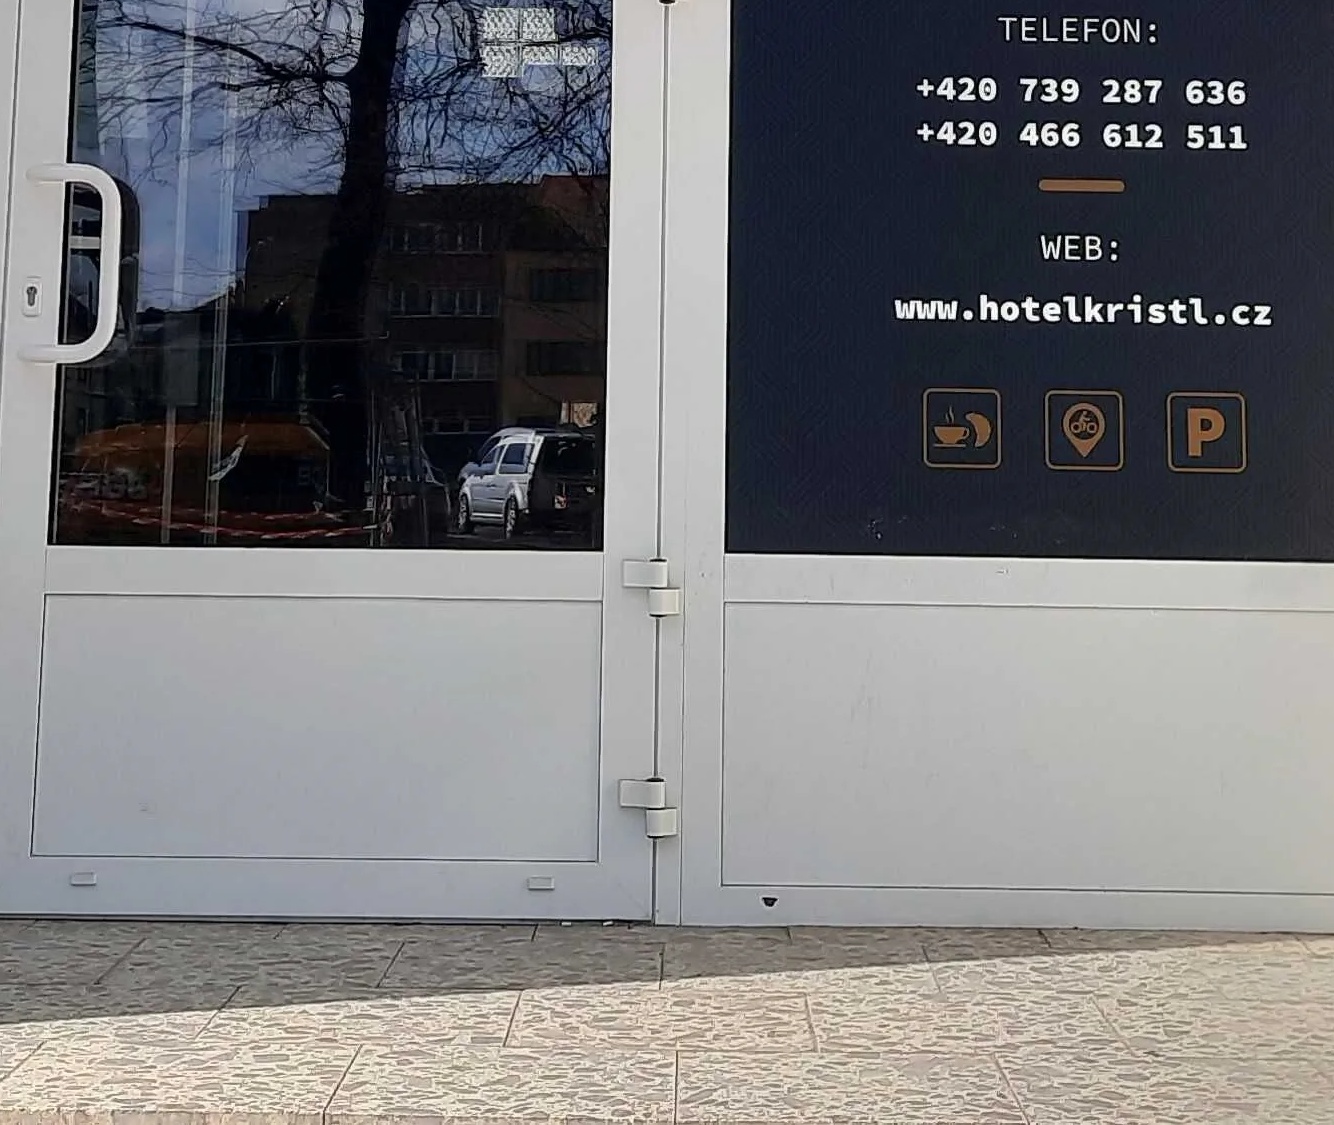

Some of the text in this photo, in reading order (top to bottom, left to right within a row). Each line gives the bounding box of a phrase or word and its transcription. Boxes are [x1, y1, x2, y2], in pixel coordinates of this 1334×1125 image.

[997, 17, 1159, 44] TELEFON:
[916, 77, 1246, 105] +420 739 287 636
[916, 121, 1247, 150] +420 466 612 511
[1040, 234, 1119, 262] WEB:
[894, 294, 1272, 326] www.hotelkristl.cz
[1187, 407, 1225, 457] P
